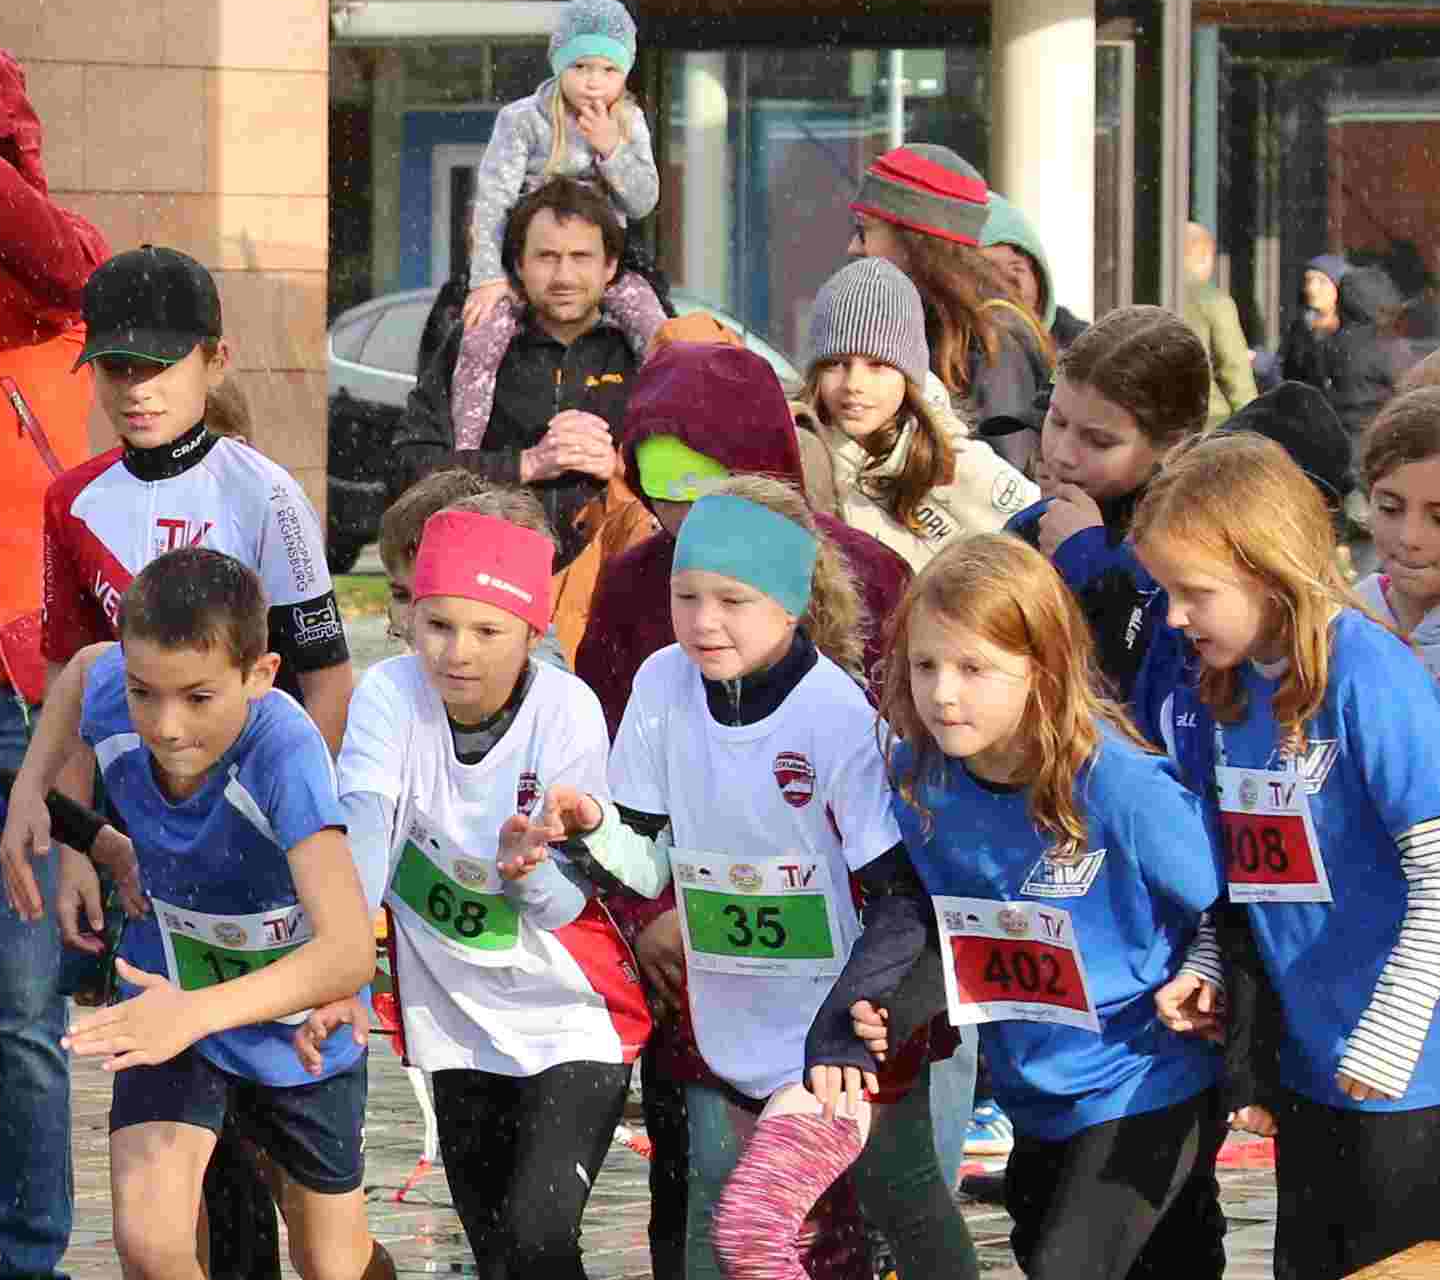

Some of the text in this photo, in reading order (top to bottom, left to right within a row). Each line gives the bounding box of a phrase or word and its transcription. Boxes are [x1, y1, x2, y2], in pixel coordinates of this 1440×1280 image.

[1225, 824, 1289, 873] 08
[426, 882, 489, 939] 68
[723, 904, 786, 949] 35
[984, 947, 1068, 996] 402
